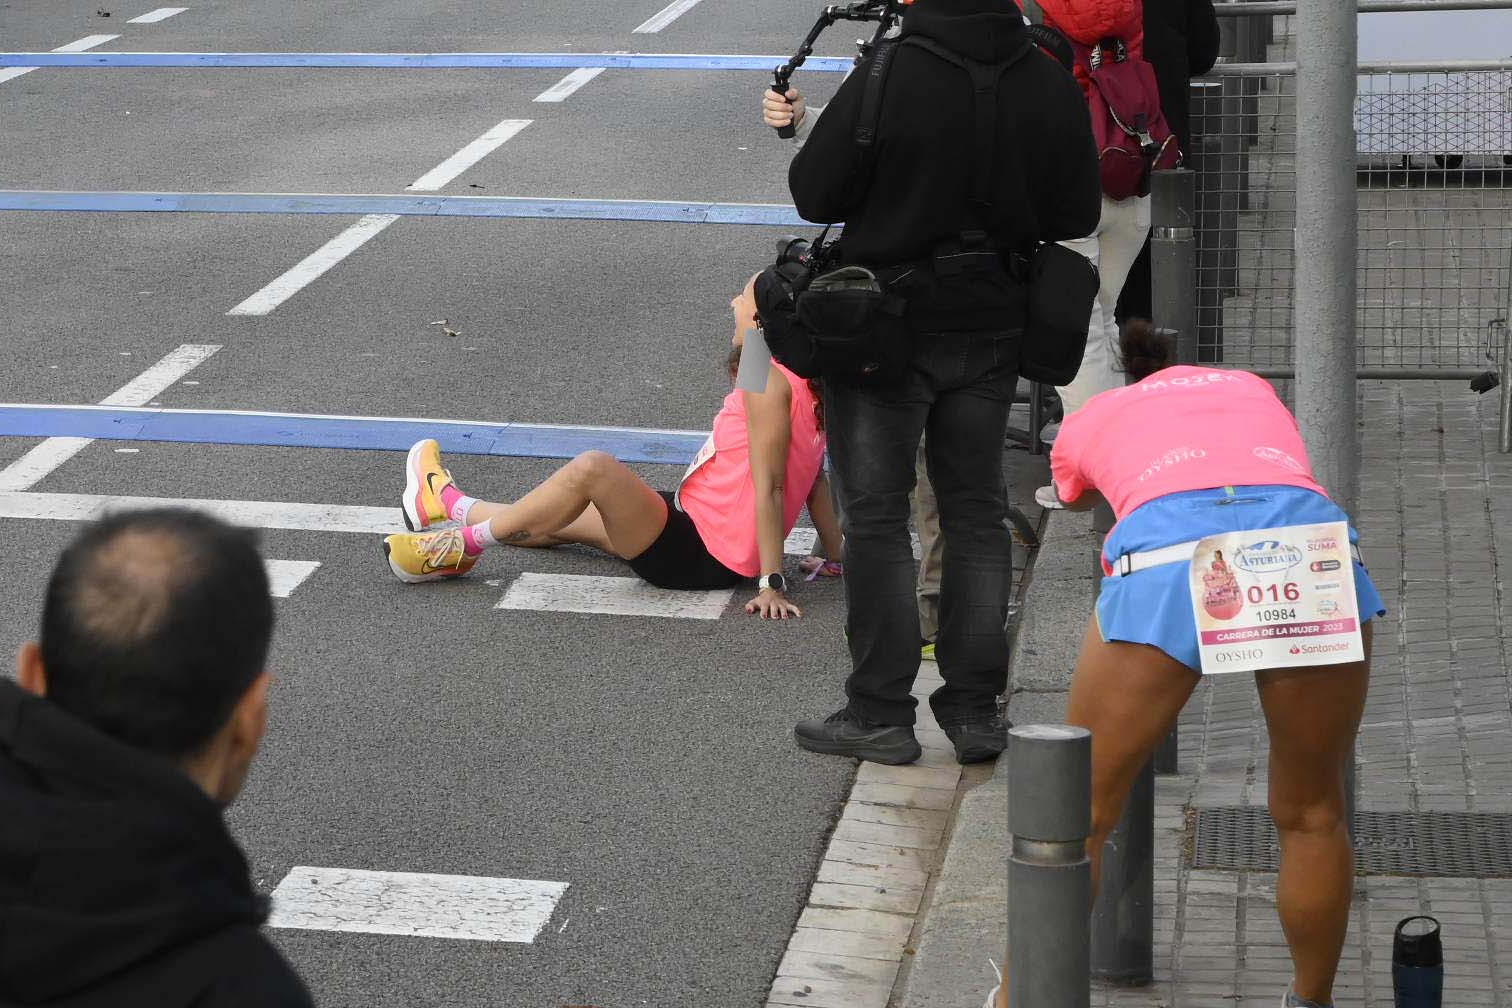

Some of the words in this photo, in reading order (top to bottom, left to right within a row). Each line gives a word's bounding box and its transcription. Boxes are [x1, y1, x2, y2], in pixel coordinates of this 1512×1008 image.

[1307, 541, 1337, 552] SUMA
[1248, 582, 1300, 604] 016
[1256, 608, 1297, 622] 10984
[1217, 630, 1260, 642] CARRERA
[1261, 628, 1275, 637] DE
[1276, 627, 1288, 635] LA
[1289, 625, 1320, 635] MUJER
[1301, 642, 1350, 654] Santander
[1216, 648, 1263, 663] OYSHO
